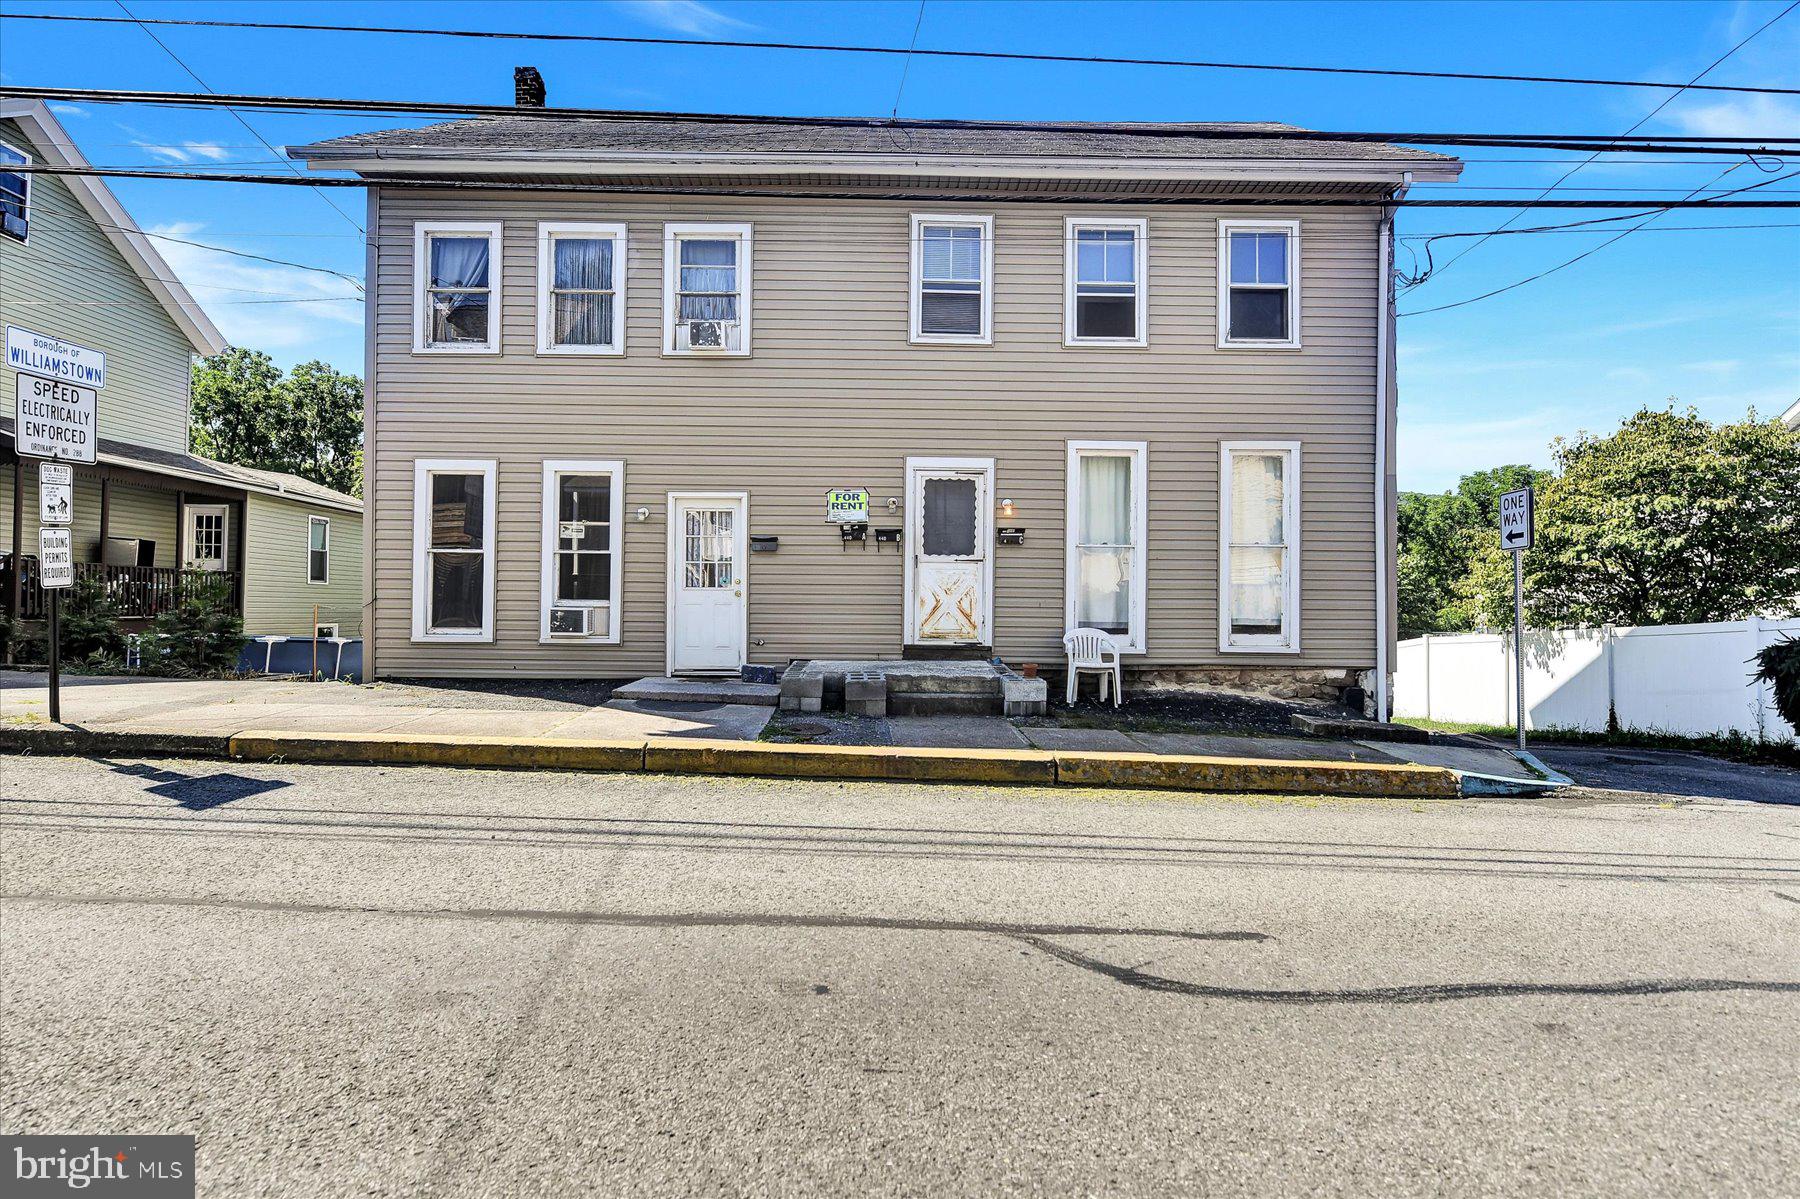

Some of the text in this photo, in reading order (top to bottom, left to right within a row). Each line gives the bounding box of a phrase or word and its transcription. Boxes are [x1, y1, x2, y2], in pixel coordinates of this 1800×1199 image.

[33, 338, 80, 358] BOROUGH OF
[11, 346, 102, 383] WILLIAMSTOWN
[33, 381, 80, 404] SPEED
[22, 399, 90, 426] ELECTRICALLY
[26, 421, 86, 445] ENFORCED
[53, 467, 68, 475] WASTE
[835, 493, 861, 501] FOR
[1503, 494, 1525, 511] ONE
[831, 502, 865, 510] RENT
[1503, 511, 1525, 527] WAY
[862, 532, 866, 540] A
[896, 533, 901, 542] B
[1018, 536, 1024, 544] C
[43, 537, 68, 548] BUILDING
[45, 552, 67, 563] PERMITS
[43, 566, 70, 578] REQUIRED
